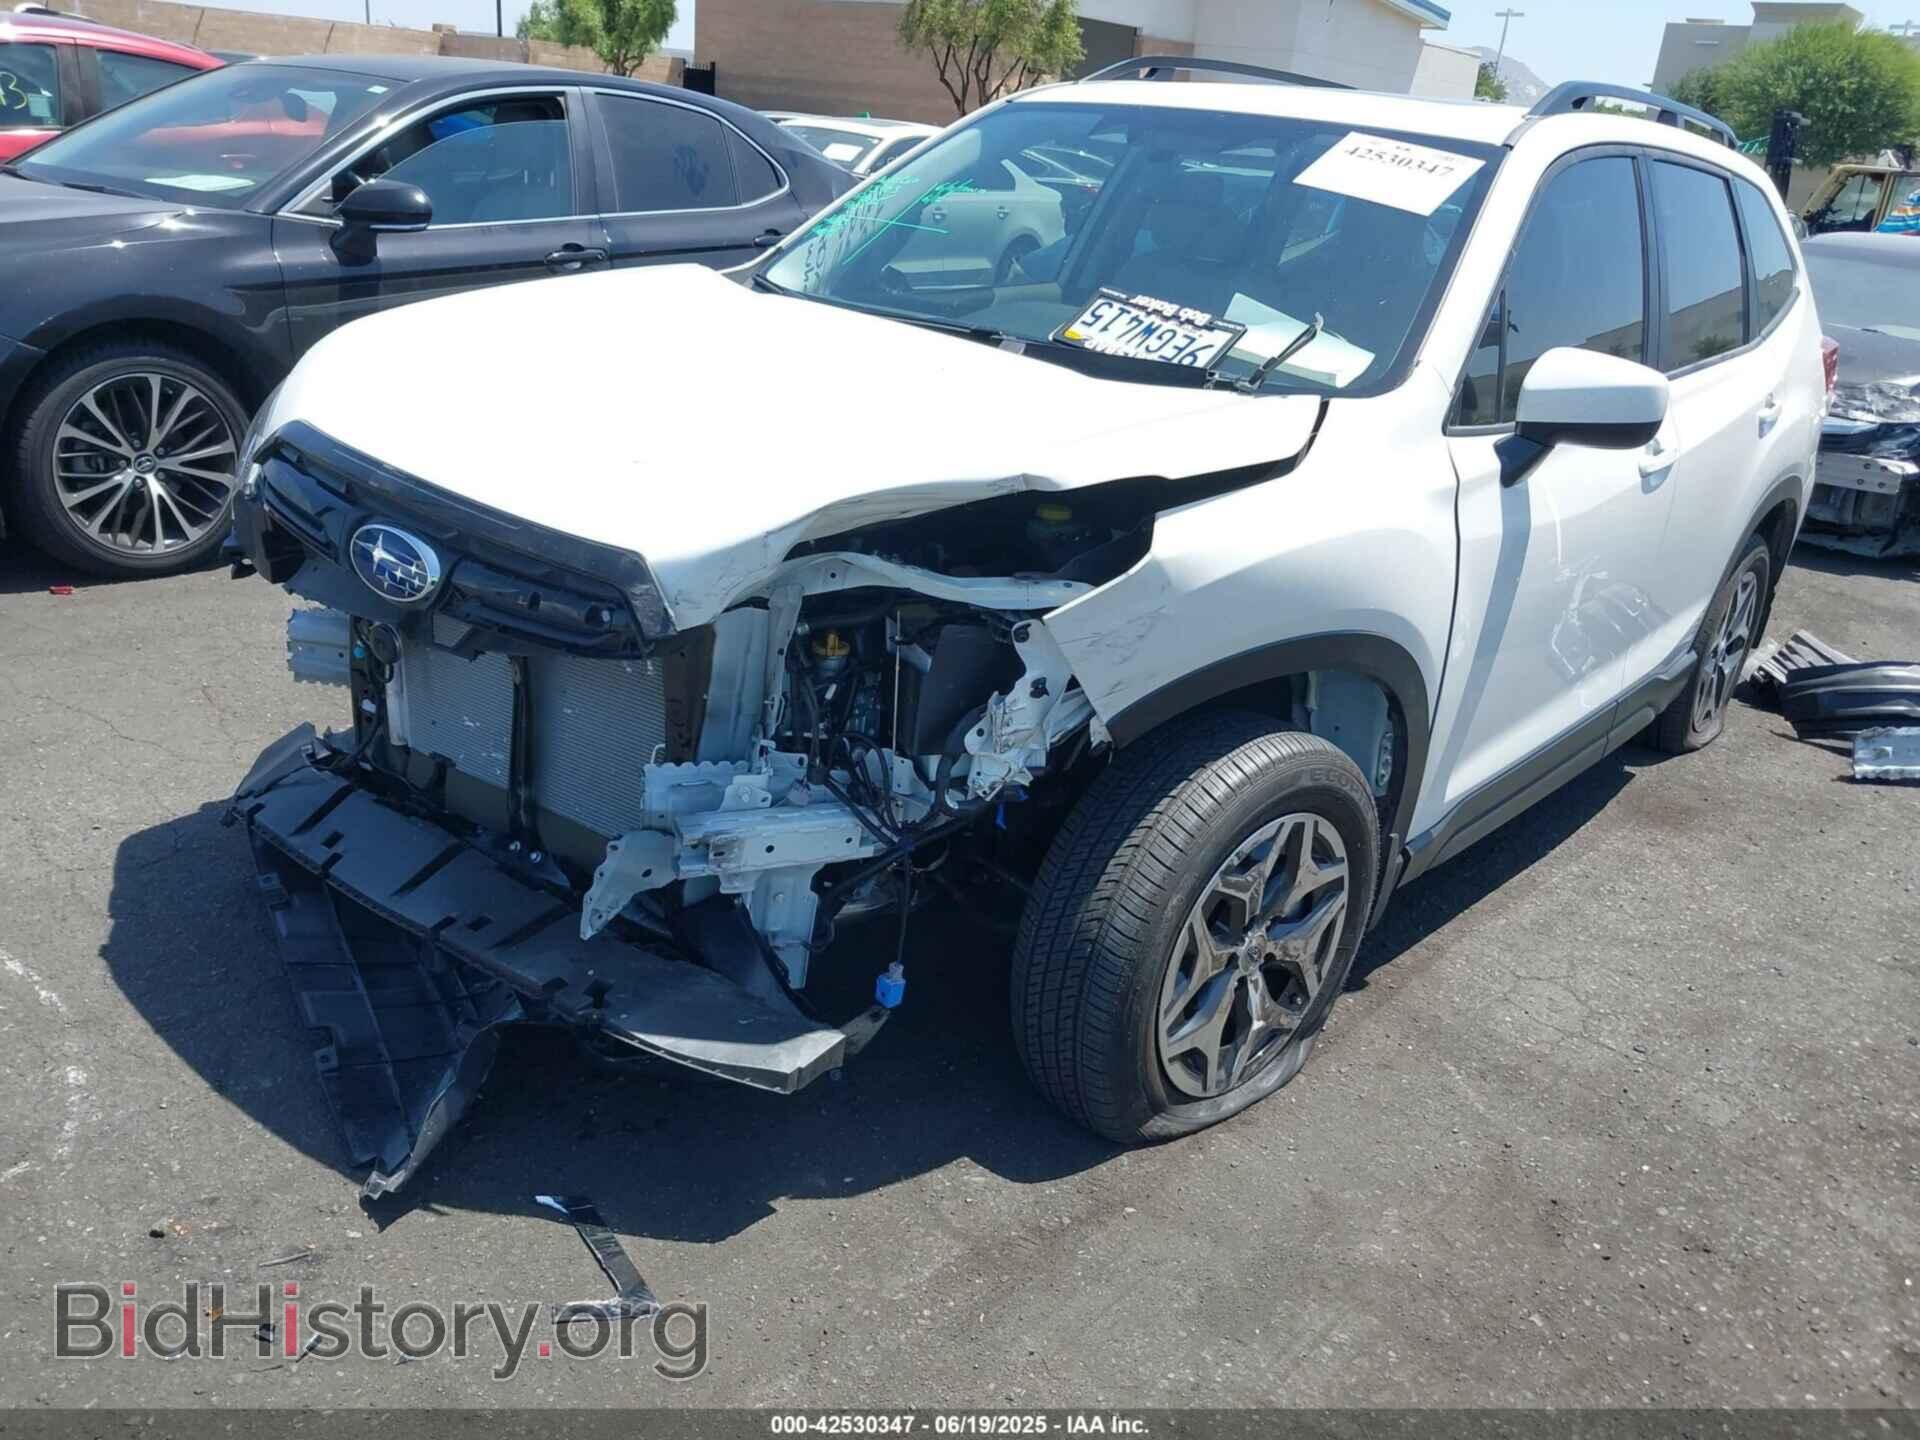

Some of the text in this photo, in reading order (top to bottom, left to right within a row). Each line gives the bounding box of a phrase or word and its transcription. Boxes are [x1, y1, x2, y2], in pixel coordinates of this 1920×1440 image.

[1345, 146, 1454, 177] 42530347
[1130, 294, 1180, 318] Baker
[1180, 306, 1213, 327] Bob
[1082, 301, 1214, 366] 9EGW415
